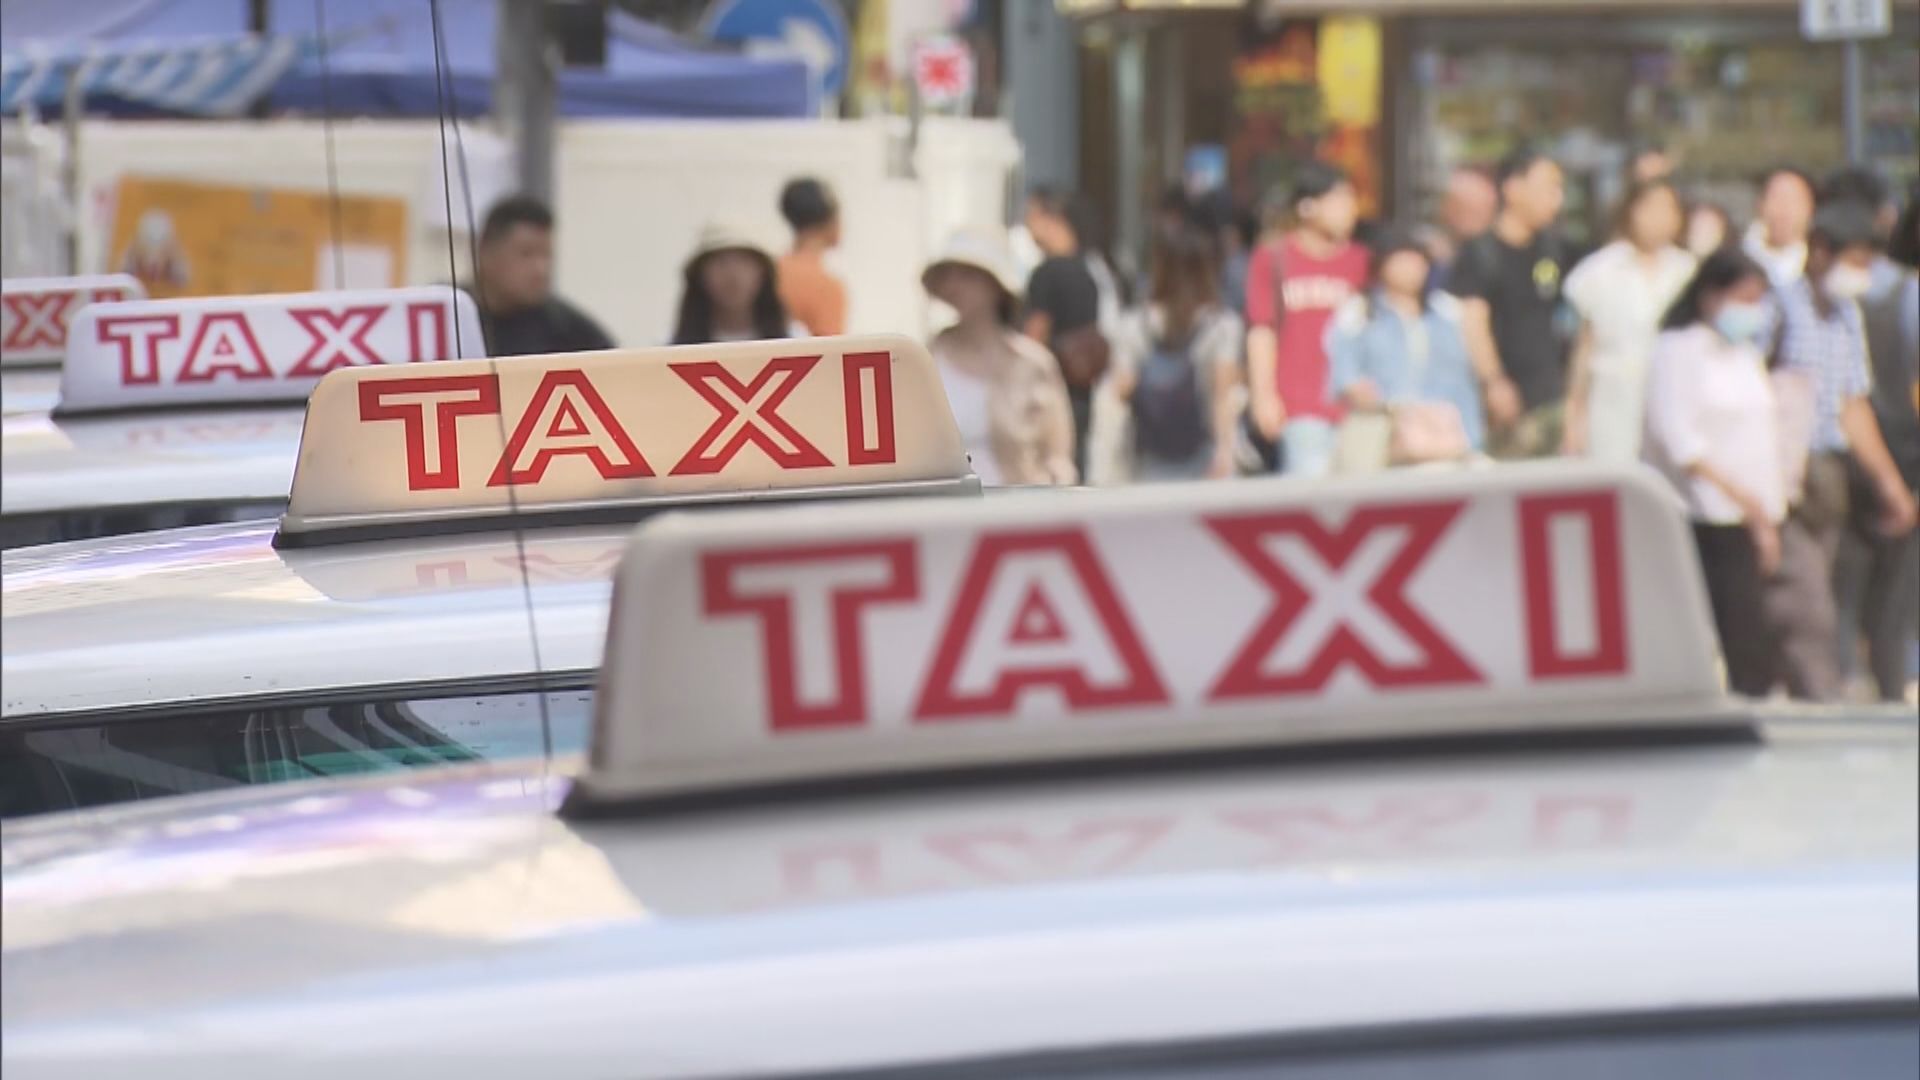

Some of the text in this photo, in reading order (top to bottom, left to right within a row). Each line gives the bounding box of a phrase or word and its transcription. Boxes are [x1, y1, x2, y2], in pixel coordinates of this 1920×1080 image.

[97, 303, 448, 385] TAXI
[357, 350, 898, 494] TAXI
[700, 489, 1630, 733] TAXI
